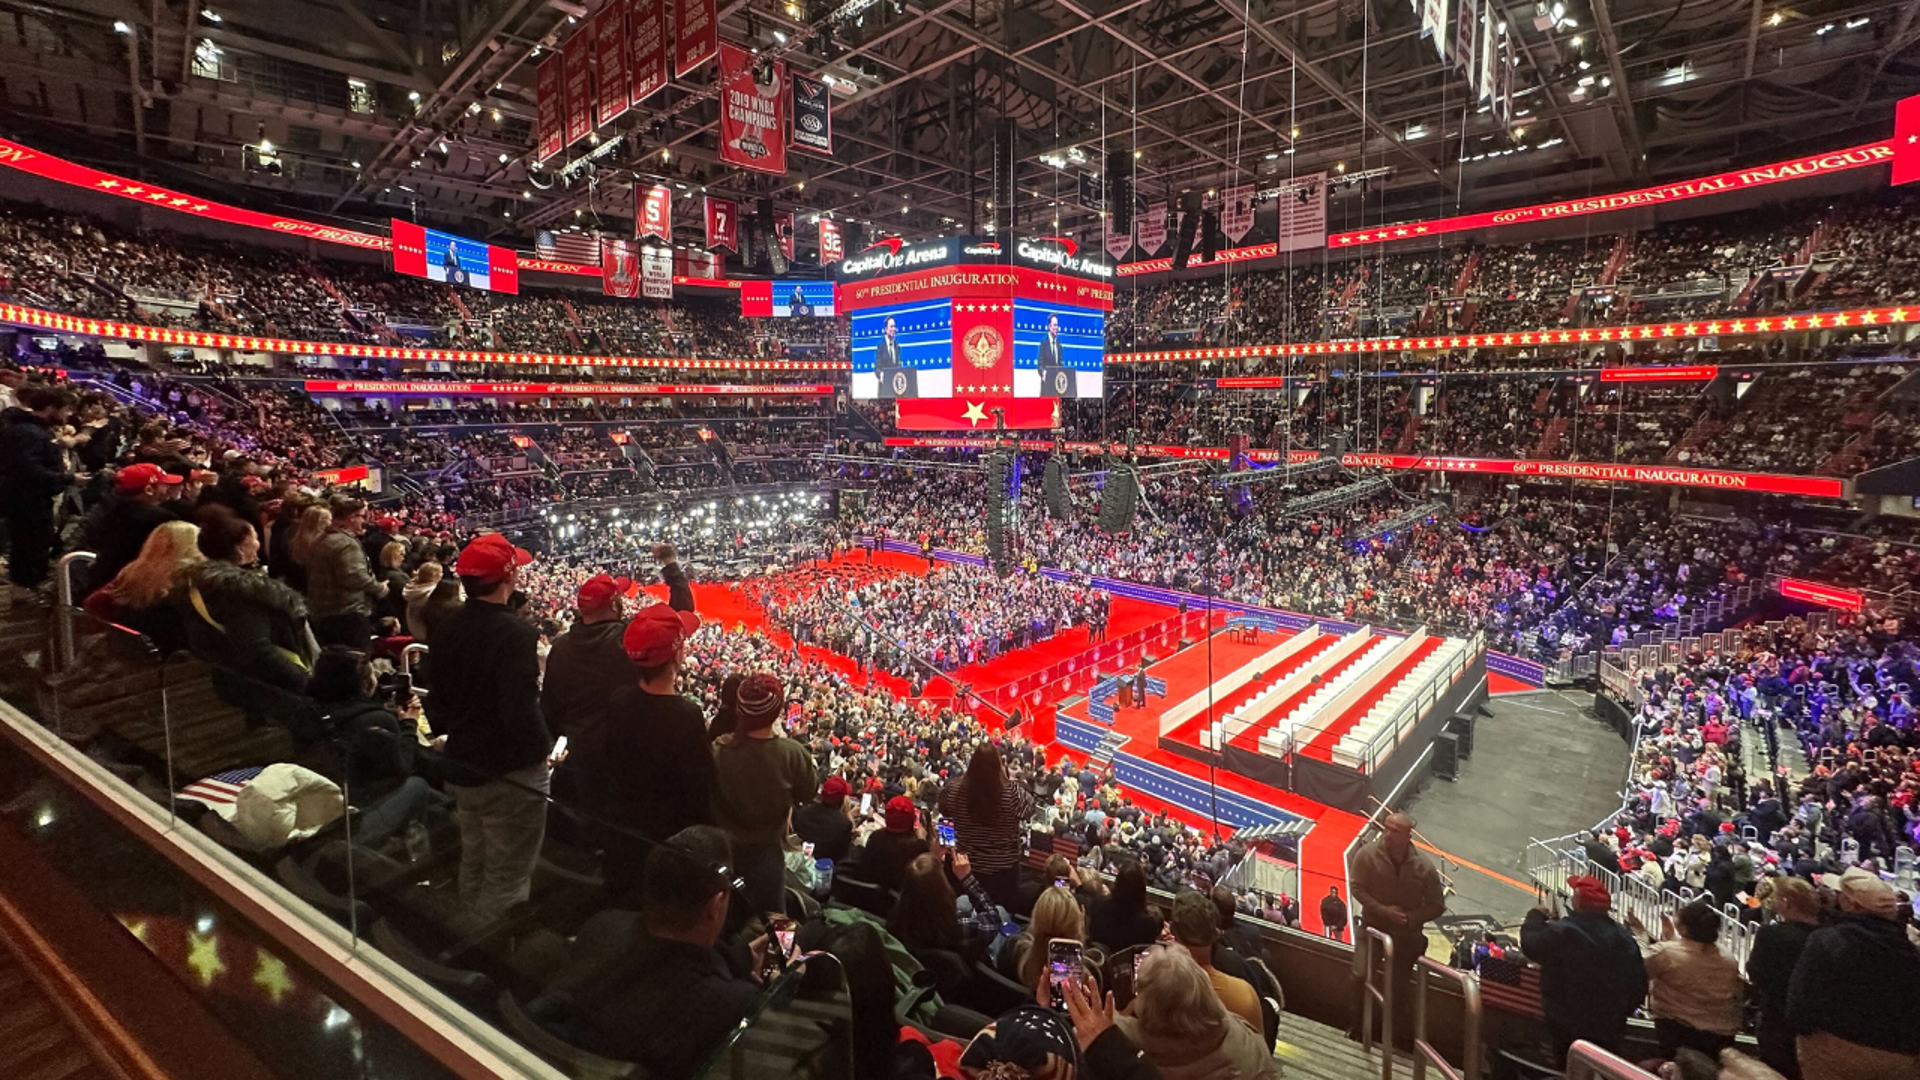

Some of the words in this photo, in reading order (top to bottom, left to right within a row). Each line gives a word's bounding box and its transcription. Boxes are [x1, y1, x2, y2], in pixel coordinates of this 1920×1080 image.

[729, 89, 749, 107] 2019
[751, 95, 775, 116] WNBA
[728, 104, 777, 130] CHAMPIONS
[1493, 210, 1533, 223] 60TH
[1540, 178, 1735, 217] PRESIDENTIAL
[1738, 145, 1895, 184] INAUGUR
[716, 212, 727, 233] 7
[823, 231, 842, 252] 32
[905, 247, 948, 265] Arena
[1080, 258, 1113, 277] Arena
[871, 278, 929, 297] PRESIDENTIAL
[930, 274, 1020, 287] INAUGURATION
[354, 382, 408, 391] PRESIDENTIAL
[410, 382, 471, 391] INAUGURATION
[562, 384, 609, 392] PRESIDENTIAL
[610, 384, 657, 392] INAUGURATION
[1513, 463, 1536, 471] 60TH
[1538, 464, 1631, 479] PRESIDENTIAL
[1634, 469, 1746, 487] INAUGURATION
